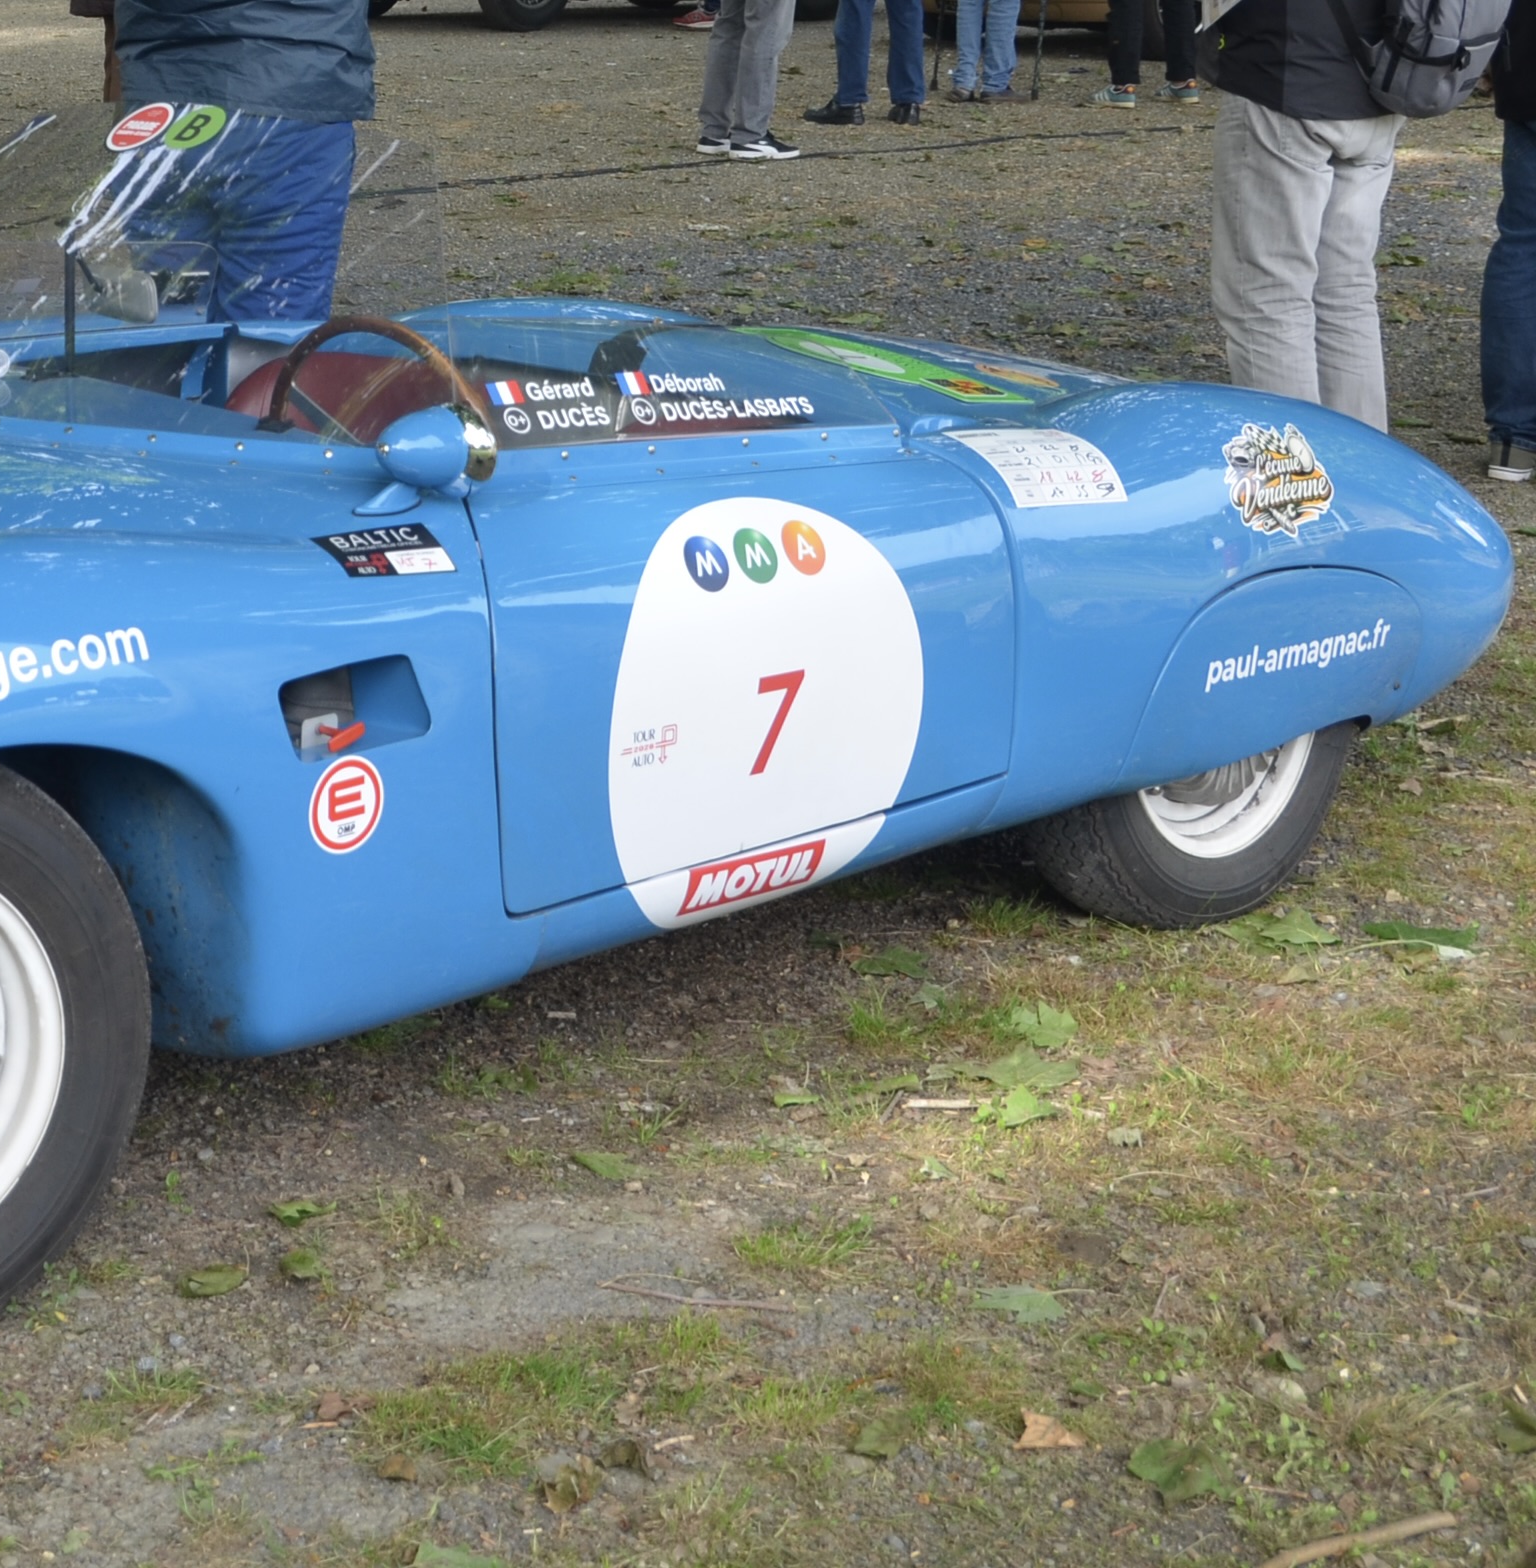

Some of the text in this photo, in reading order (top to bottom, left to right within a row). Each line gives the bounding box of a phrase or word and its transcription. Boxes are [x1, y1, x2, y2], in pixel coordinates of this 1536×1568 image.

[173, 113, 212, 142] B
[525, 377, 595, 402] Gérard
[649, 372, 726, 395] Déborah
[537, 402, 611, 430] DUCÈS
[660, 396, 815, 422] DUCÈS-LASBATS
[1236, 473, 1329, 519] Vendéenne
[329, 527, 420, 549] BALTIC
[1205, 618, 1391, 693] paul-armagnac.fr
[633, 728, 656, 744] TOUR
[749, 669, 805, 776] 7
[631, 752, 655, 768] AUTO
[328, 775, 365, 823] E
[337, 823, 356, 836] OMP
[686, 847, 815, 911] MOTUL
